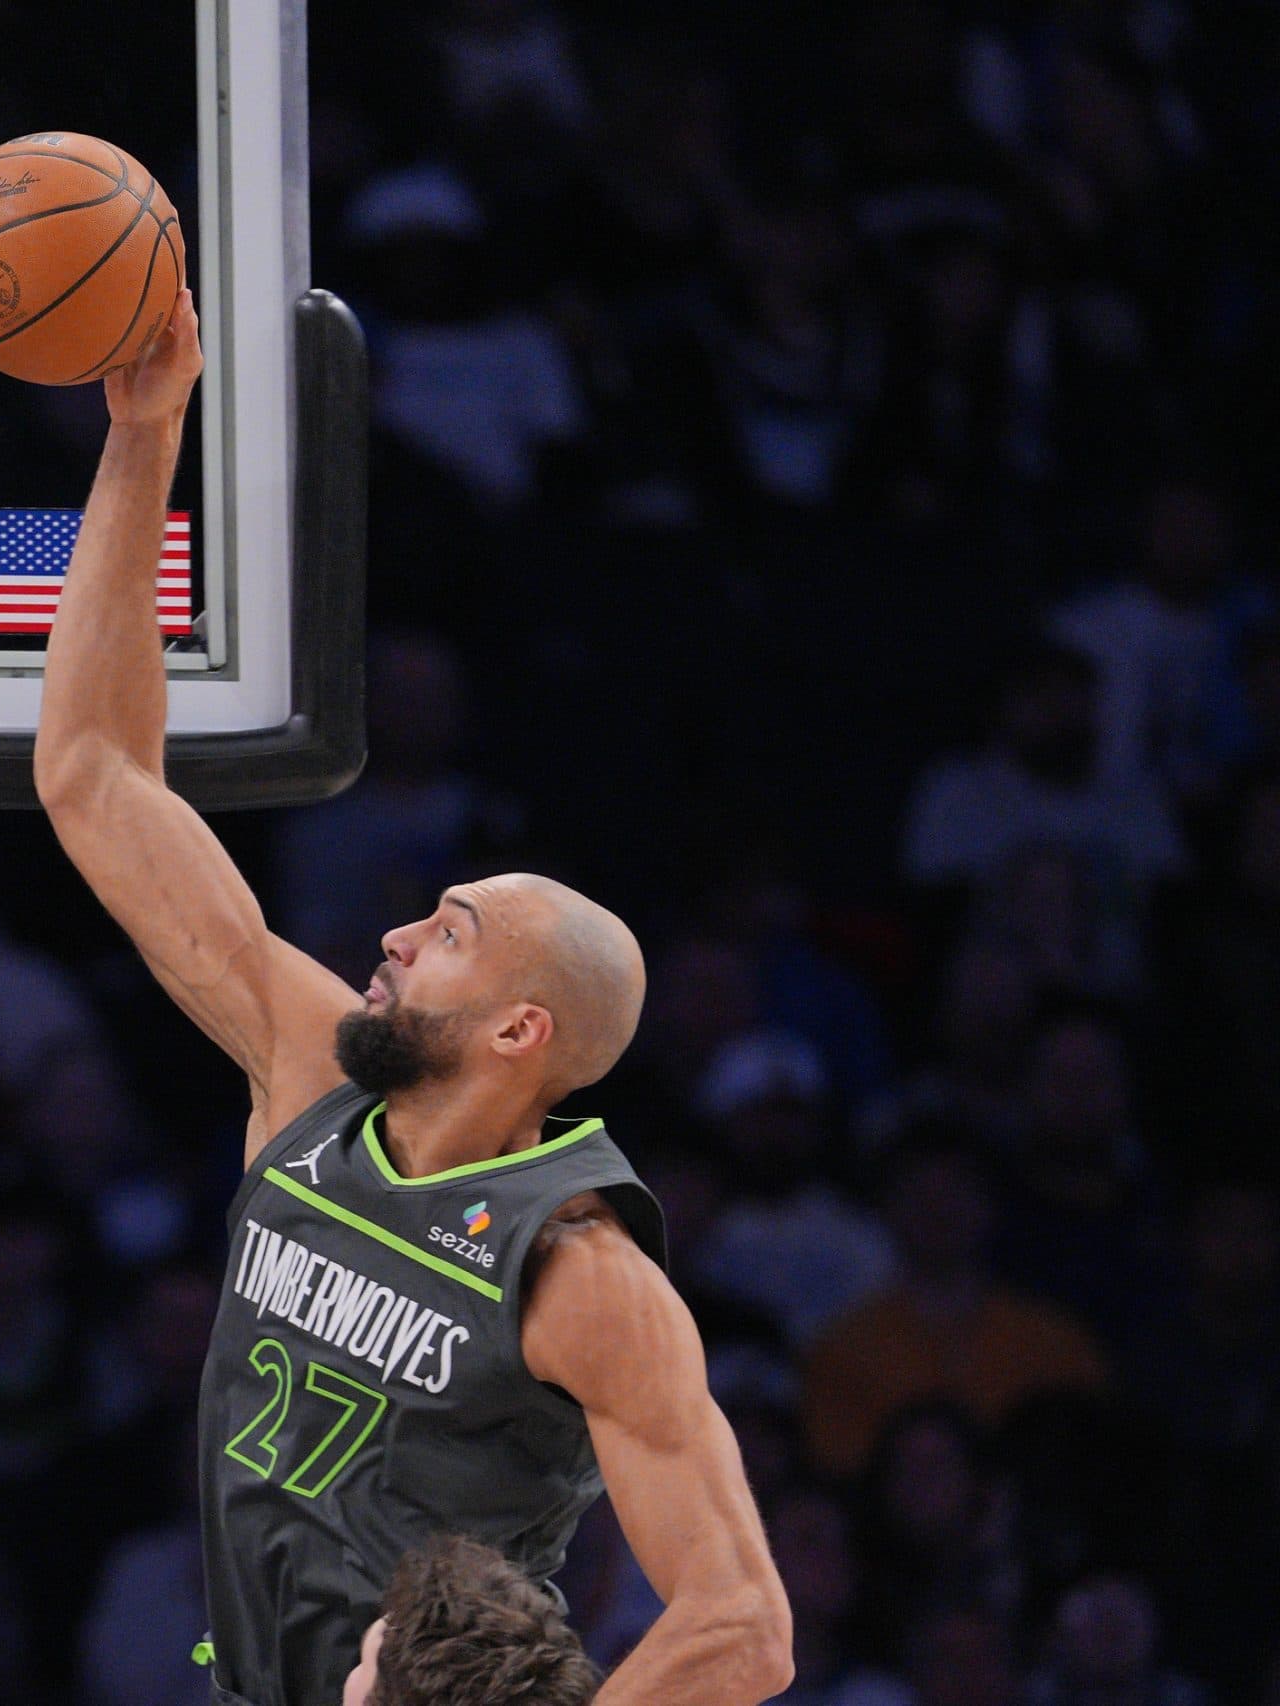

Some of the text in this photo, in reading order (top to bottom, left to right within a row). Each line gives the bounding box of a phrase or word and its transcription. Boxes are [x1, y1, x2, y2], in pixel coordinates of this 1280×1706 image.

[233, 1219, 470, 1394] TIMBERWOLVES
[427, 1223, 495, 1268] sezzle
[224, 1338, 388, 1499] 27
